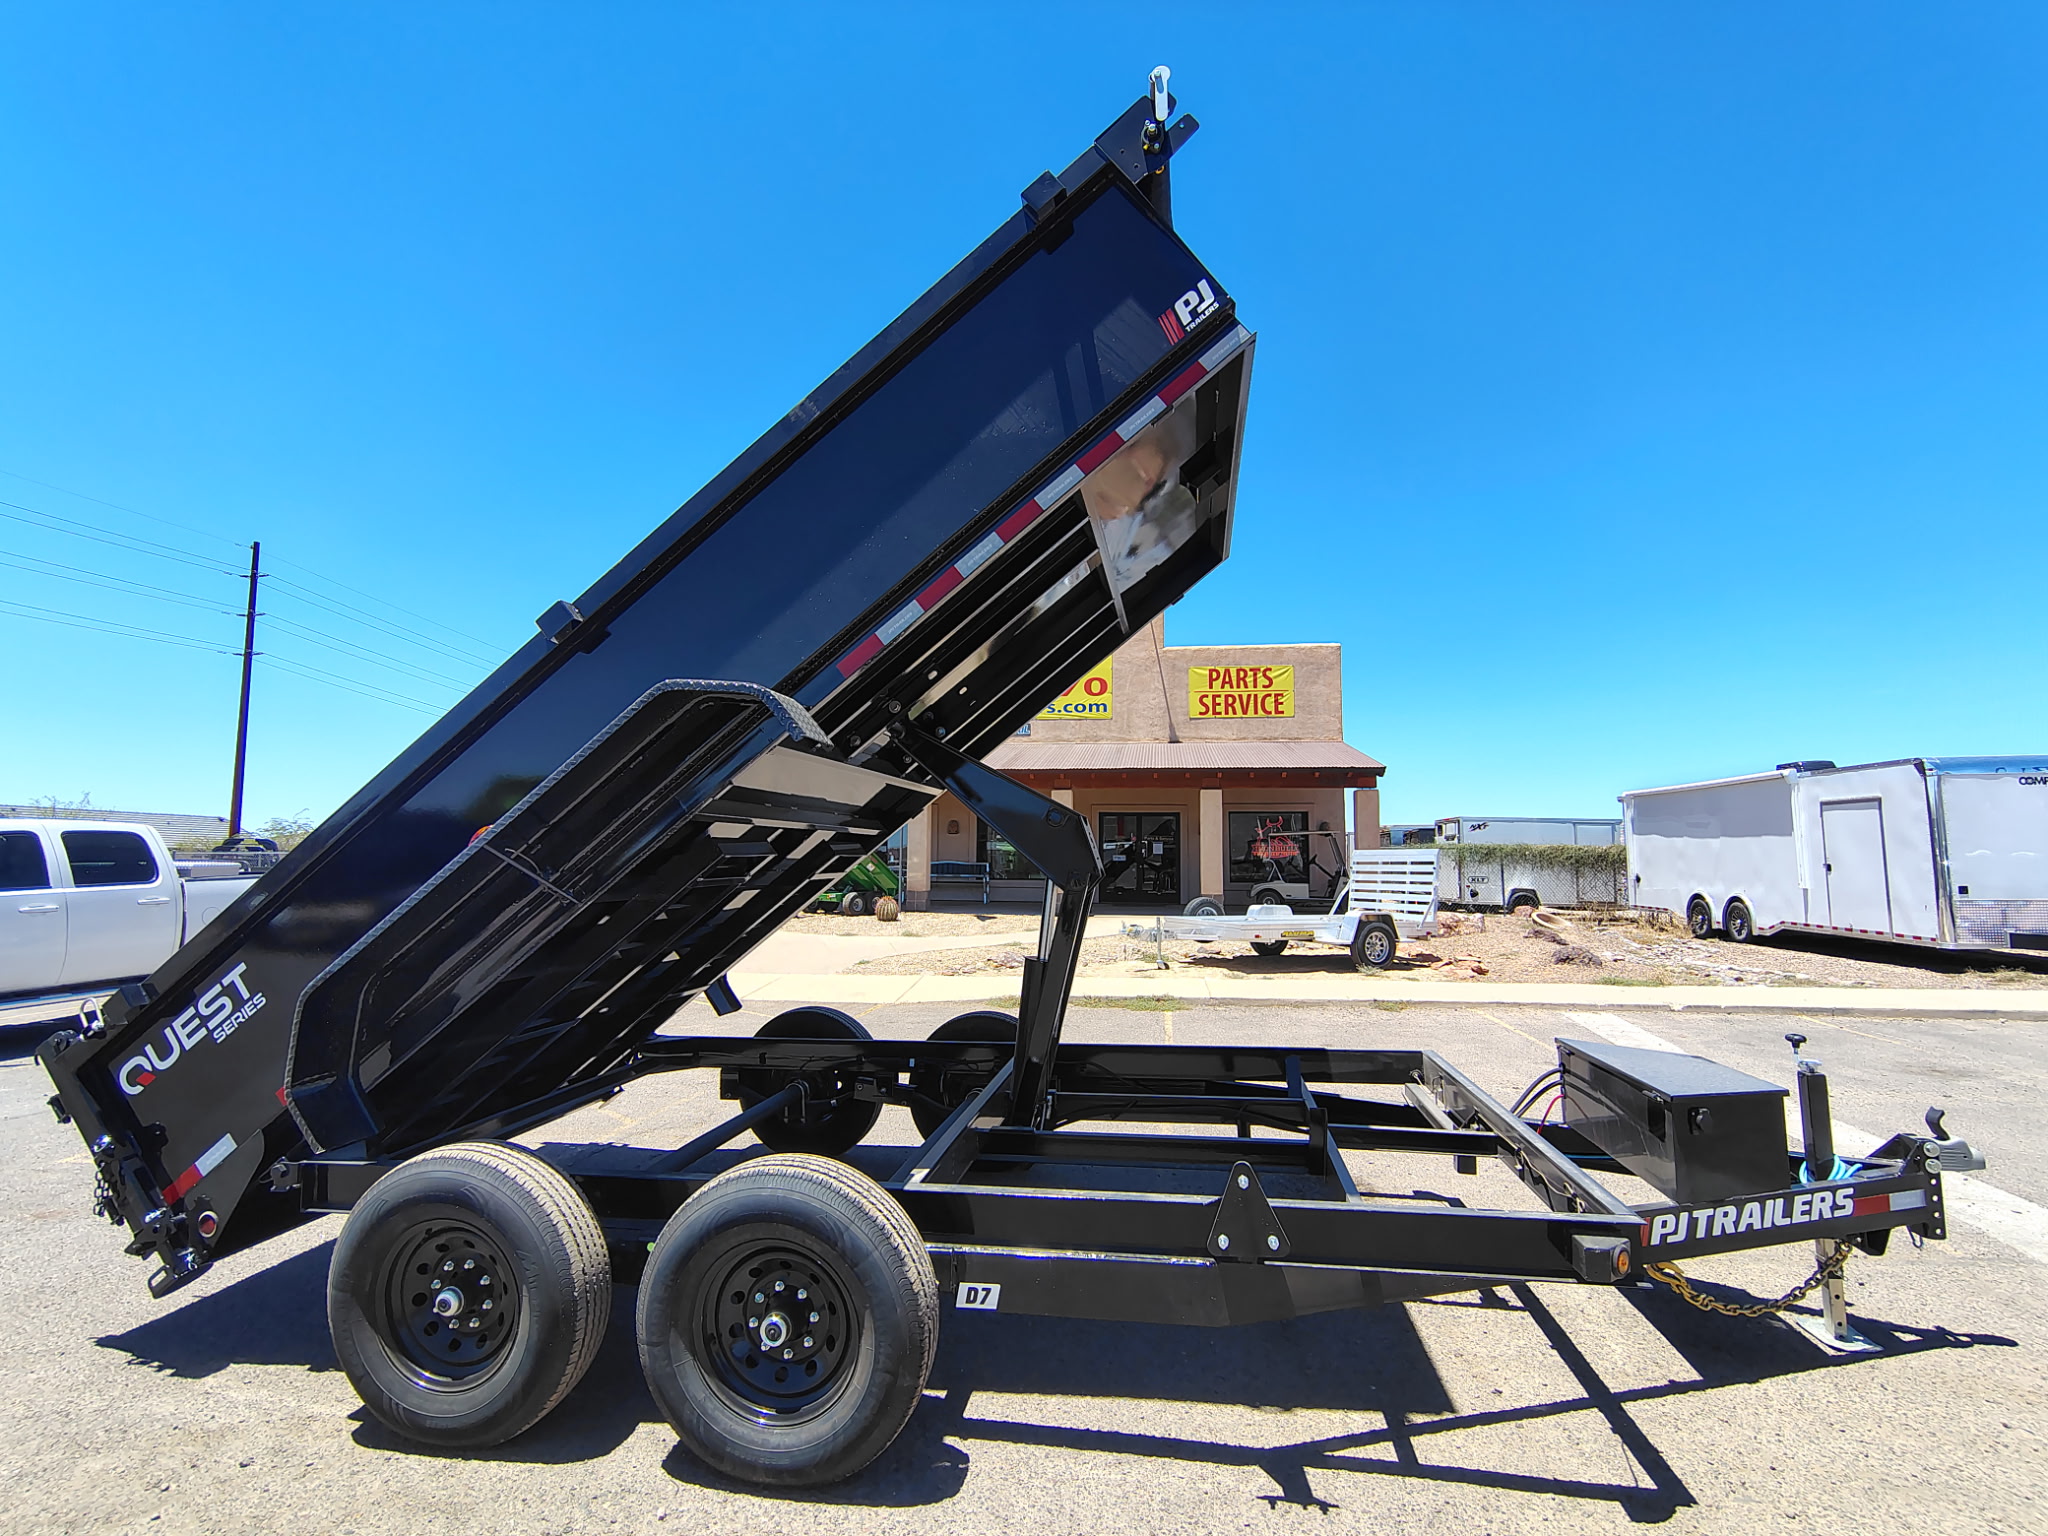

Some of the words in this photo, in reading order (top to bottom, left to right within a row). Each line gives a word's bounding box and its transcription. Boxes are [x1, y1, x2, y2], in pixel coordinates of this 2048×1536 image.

[1174, 278, 1215, 327] PJ
[1184, 301, 1220, 332] TRAILERS
[1207, 667, 1274, 690] PARTS
[1198, 693, 1285, 716] SERVICE
[119, 961, 251, 1095] QUEST
[212, 992, 267, 1044] SERIES
[1650, 1212, 1689, 1247] PJ
[1692, 1187, 1855, 1240] TRAILERS
[965, 1286, 992, 1305] D7
